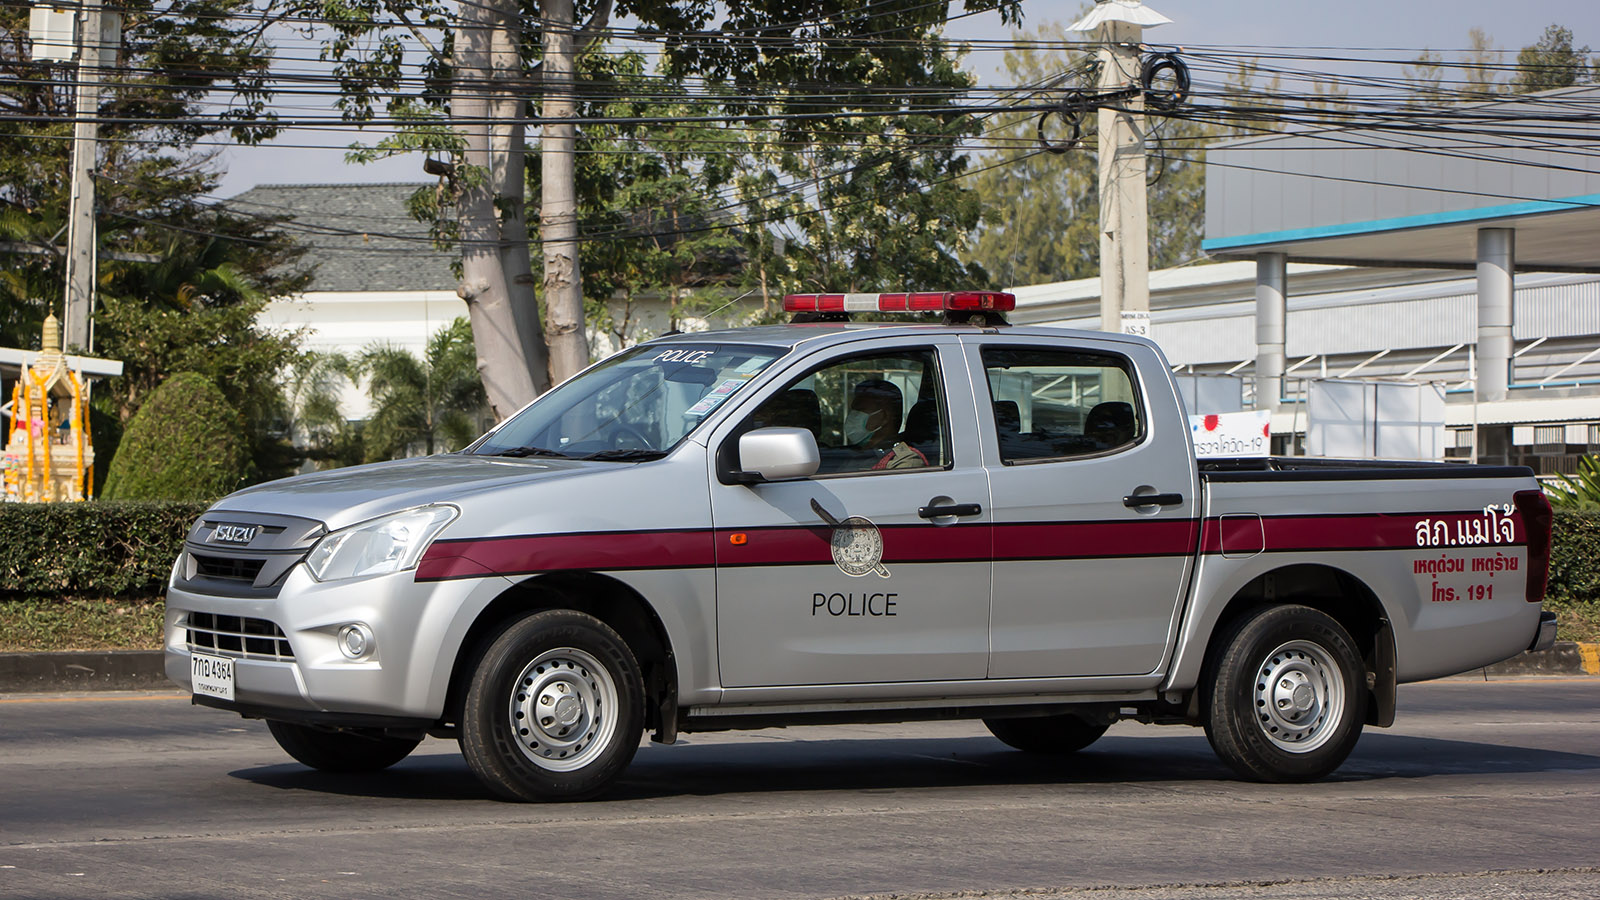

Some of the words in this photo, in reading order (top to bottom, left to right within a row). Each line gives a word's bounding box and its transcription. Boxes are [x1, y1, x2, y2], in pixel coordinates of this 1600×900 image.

[652, 349, 714, 364] POLICE
[214, 524, 256, 542] ISUZU
[1415, 503, 1515, 547] สภ.แม่โจ้
[1413, 553, 1465, 579] เหตุด่วน
[1471, 552, 1519, 577] เหตุร้าย
[1432, 581, 1460, 602] โทร.
[1467, 584, 1493, 600] 191
[812, 592, 898, 616] POLICE
[212, 660, 232, 681] 4364
